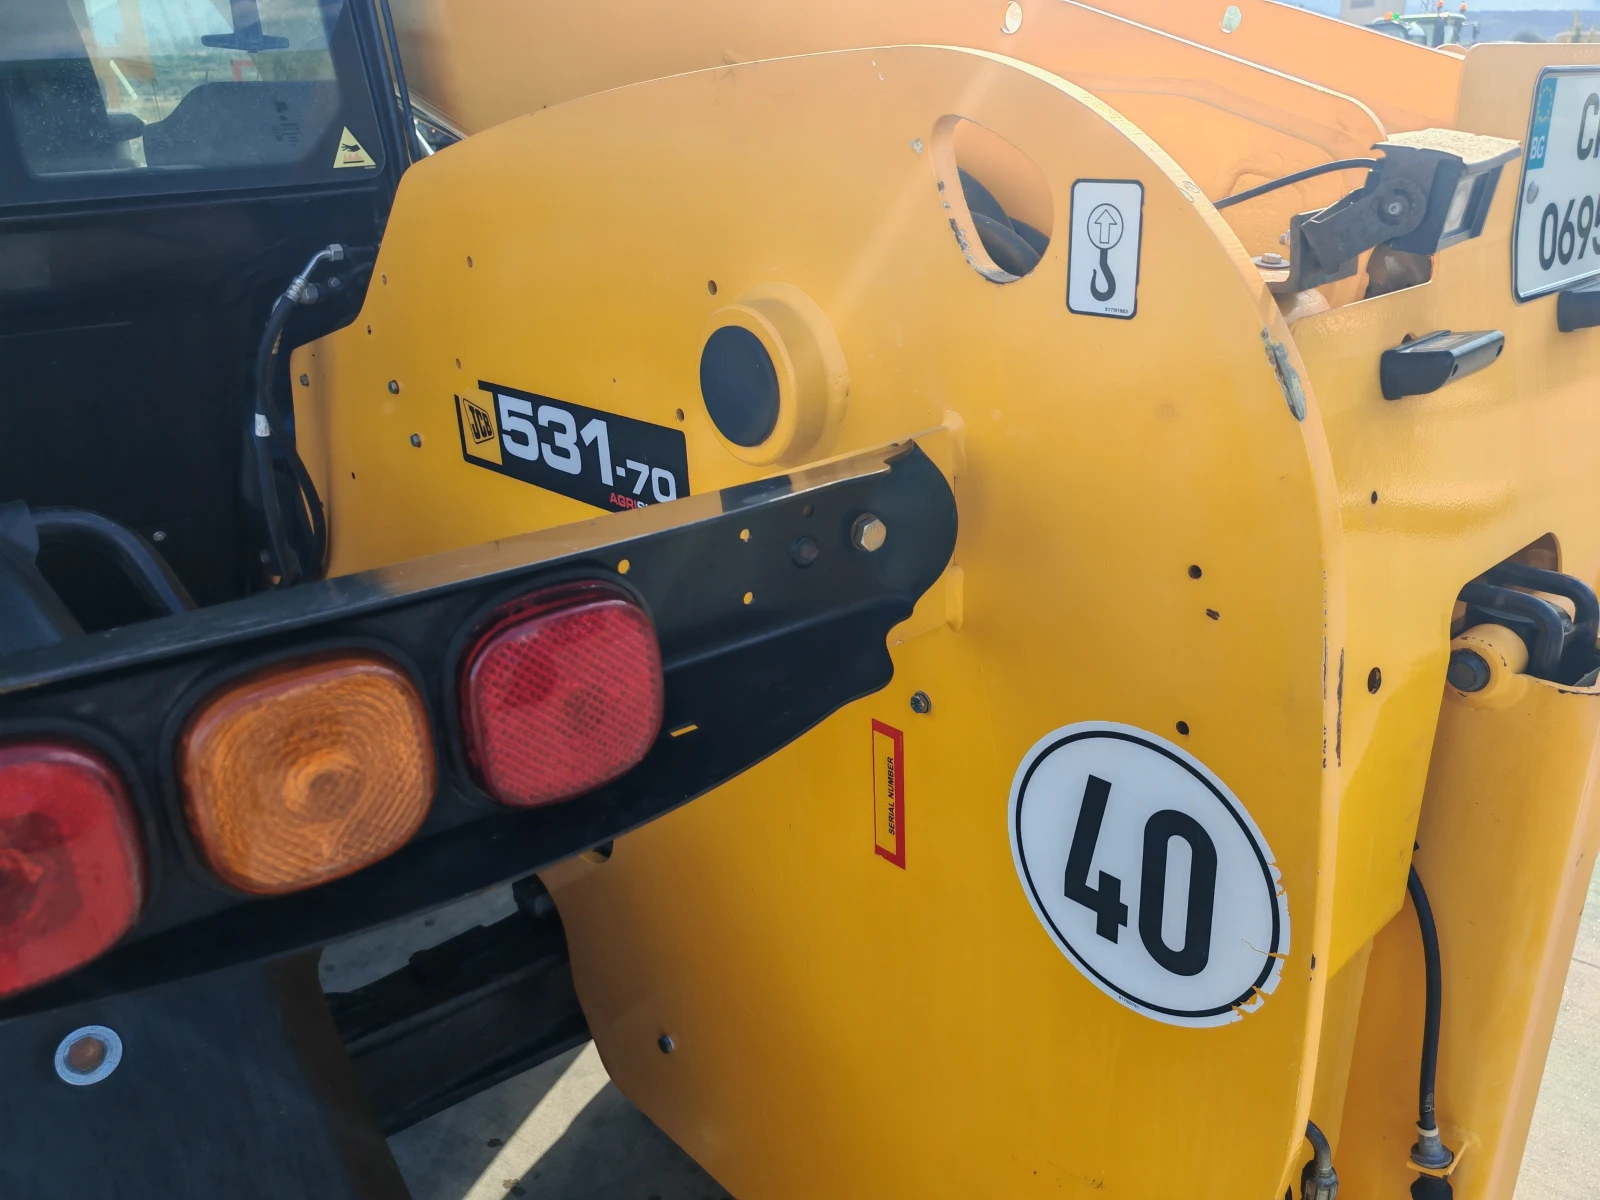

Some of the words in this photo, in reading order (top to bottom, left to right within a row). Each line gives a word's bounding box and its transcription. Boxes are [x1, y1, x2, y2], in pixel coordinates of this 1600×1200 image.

[1530, 136, 1544, 159] BG
[1576, 92, 1600, 160] C
[468, 405, 493, 440] JCB
[887, 756, 895, 799] NUMBER
[1063, 773, 1218, 977] 40
